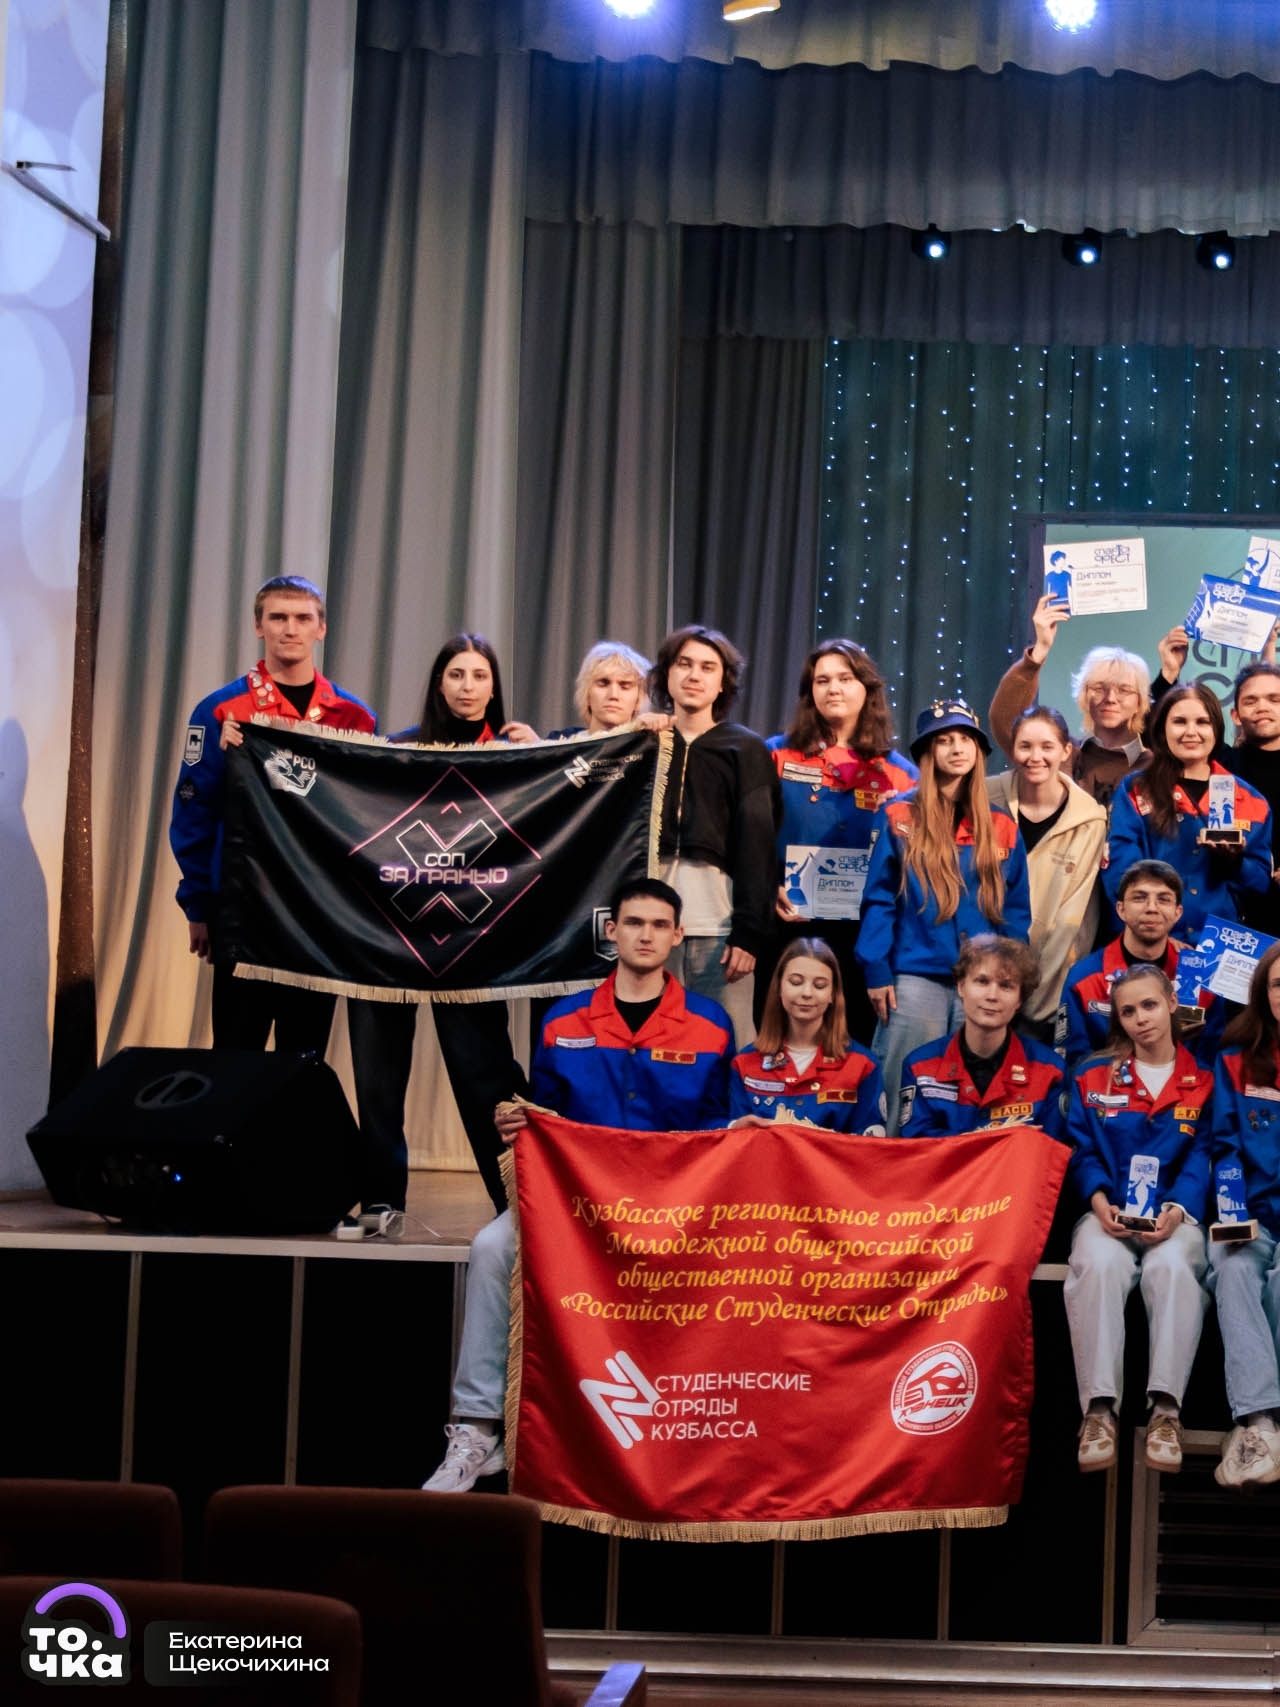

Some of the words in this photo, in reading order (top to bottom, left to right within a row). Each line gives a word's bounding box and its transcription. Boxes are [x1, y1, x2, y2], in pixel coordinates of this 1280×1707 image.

[292, 753, 316, 771] РСО
[424, 852, 466, 867] СОП
[379, 865, 409, 884] ЗА
[414, 866, 508, 885] ГРАНЬЮ
[573, 1195, 704, 1230] Кузбасское
[709, 1203, 880, 1230] региональное
[886, 1193, 1012, 1228] отделение
[606, 1228, 768, 1257] Молодежной
[774, 1231, 974, 1265] общероссийской
[616, 1261, 794, 1295] общественной
[800, 1265, 961, 1296] организации
[560, 1290, 708, 1327] «Российские
[715, 1294, 891, 1327] Студенческие
[898, 1285, 1010, 1326] Отряды»
[653, 1371, 813, 1393] СТУДЕНЧЕСКИЕ
[651, 1397, 738, 1419] ОТРЯДЫ
[650, 1420, 759, 1442] КУЗБАССА
